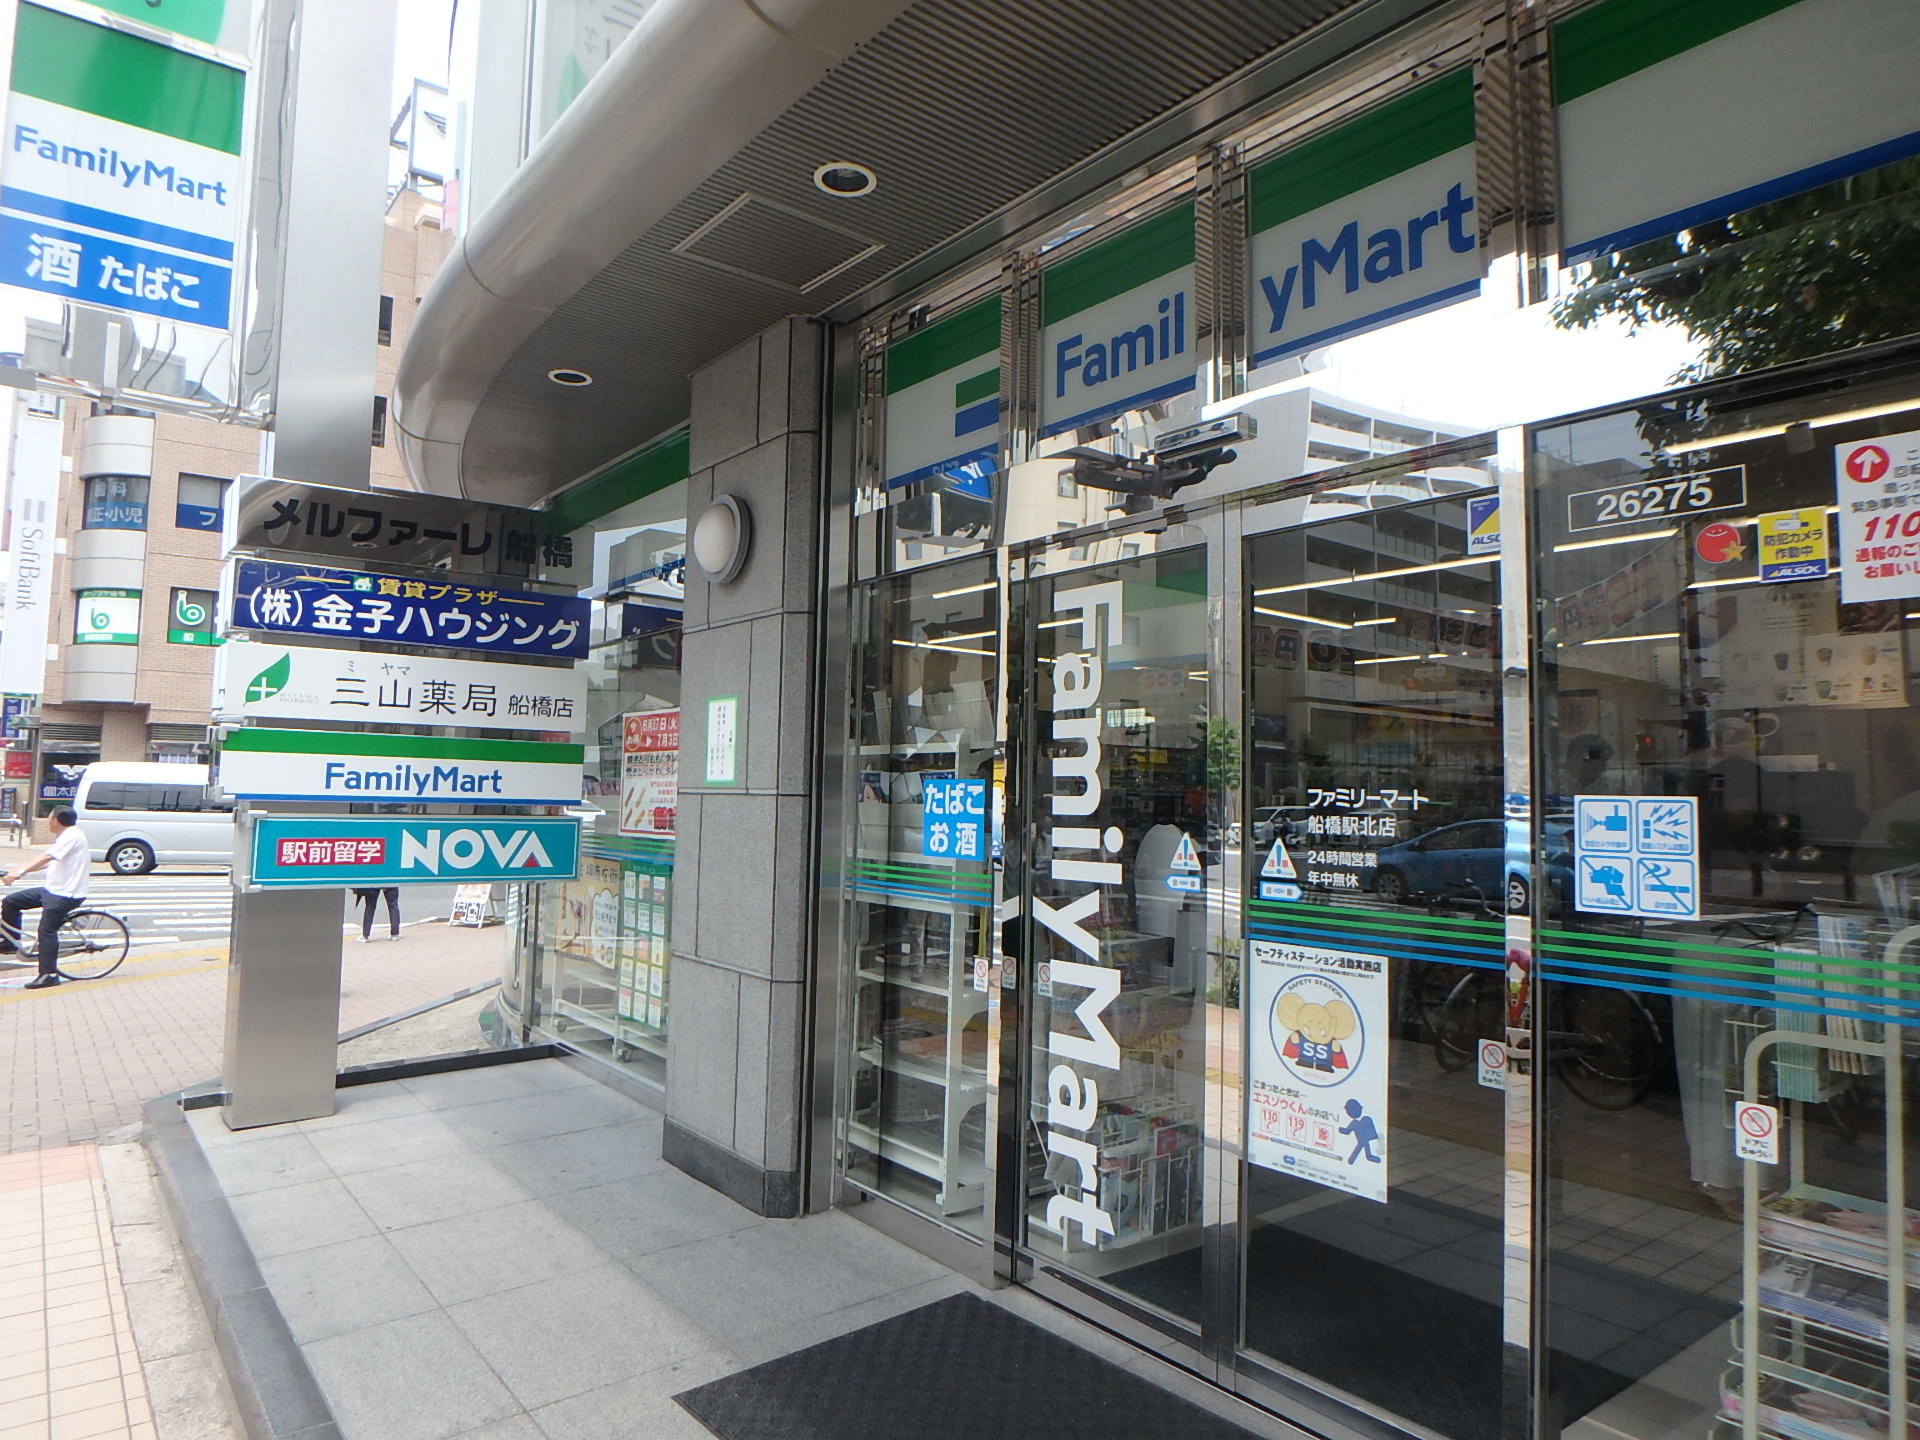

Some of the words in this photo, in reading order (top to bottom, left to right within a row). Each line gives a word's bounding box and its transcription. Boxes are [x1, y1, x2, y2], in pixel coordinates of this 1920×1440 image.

[14, 124, 227, 206] FamilyMart
[26, 233, 82, 288] 酒
[98, 255, 200, 309] たばこ
[1259, 182, 1476, 333] yMart
[1056, 291, 1185, 398] Famil
[1596, 477, 1713, 522] 26275
[263, 498, 492, 556] メルファーレ
[504, 529, 574, 570] 船橋
[1763, 528, 1824, 547] 防犯カメラ
[15, 527, 44, 611] SoftBank
[1775, 545, 1814, 560] 作動中
[1776, 564, 1822, 577] ALSOK
[377, 577, 499, 606] 賃貸プラザ
[330, 676, 498, 718] 三山薬局
[508, 693, 574, 719] 船橋店
[324, 762, 503, 796] FamilyMart
[924, 782, 985, 815] たばこ
[1307, 788, 1430, 811] ファミリーマート
[929, 821, 978, 857] お酒
[1307, 815, 1396, 837] 船橋駅北店
[281, 840, 382, 864] 駅前留学
[400, 828, 553, 876] NOVA
[1307, 850, 1378, 869] 24時間営業
[1307, 871, 1359, 888] 年中無休
[1033, 578, 1121, 1247] FamilyMart
[1288, 978, 1312, 992] SAFETY
[1314, 978, 1344, 999] STATION
[1302, 1041, 1328, 1060] SS
[1262, 1109, 1278, 1122] 110
[1288, 1116, 1305, 1130] 119
